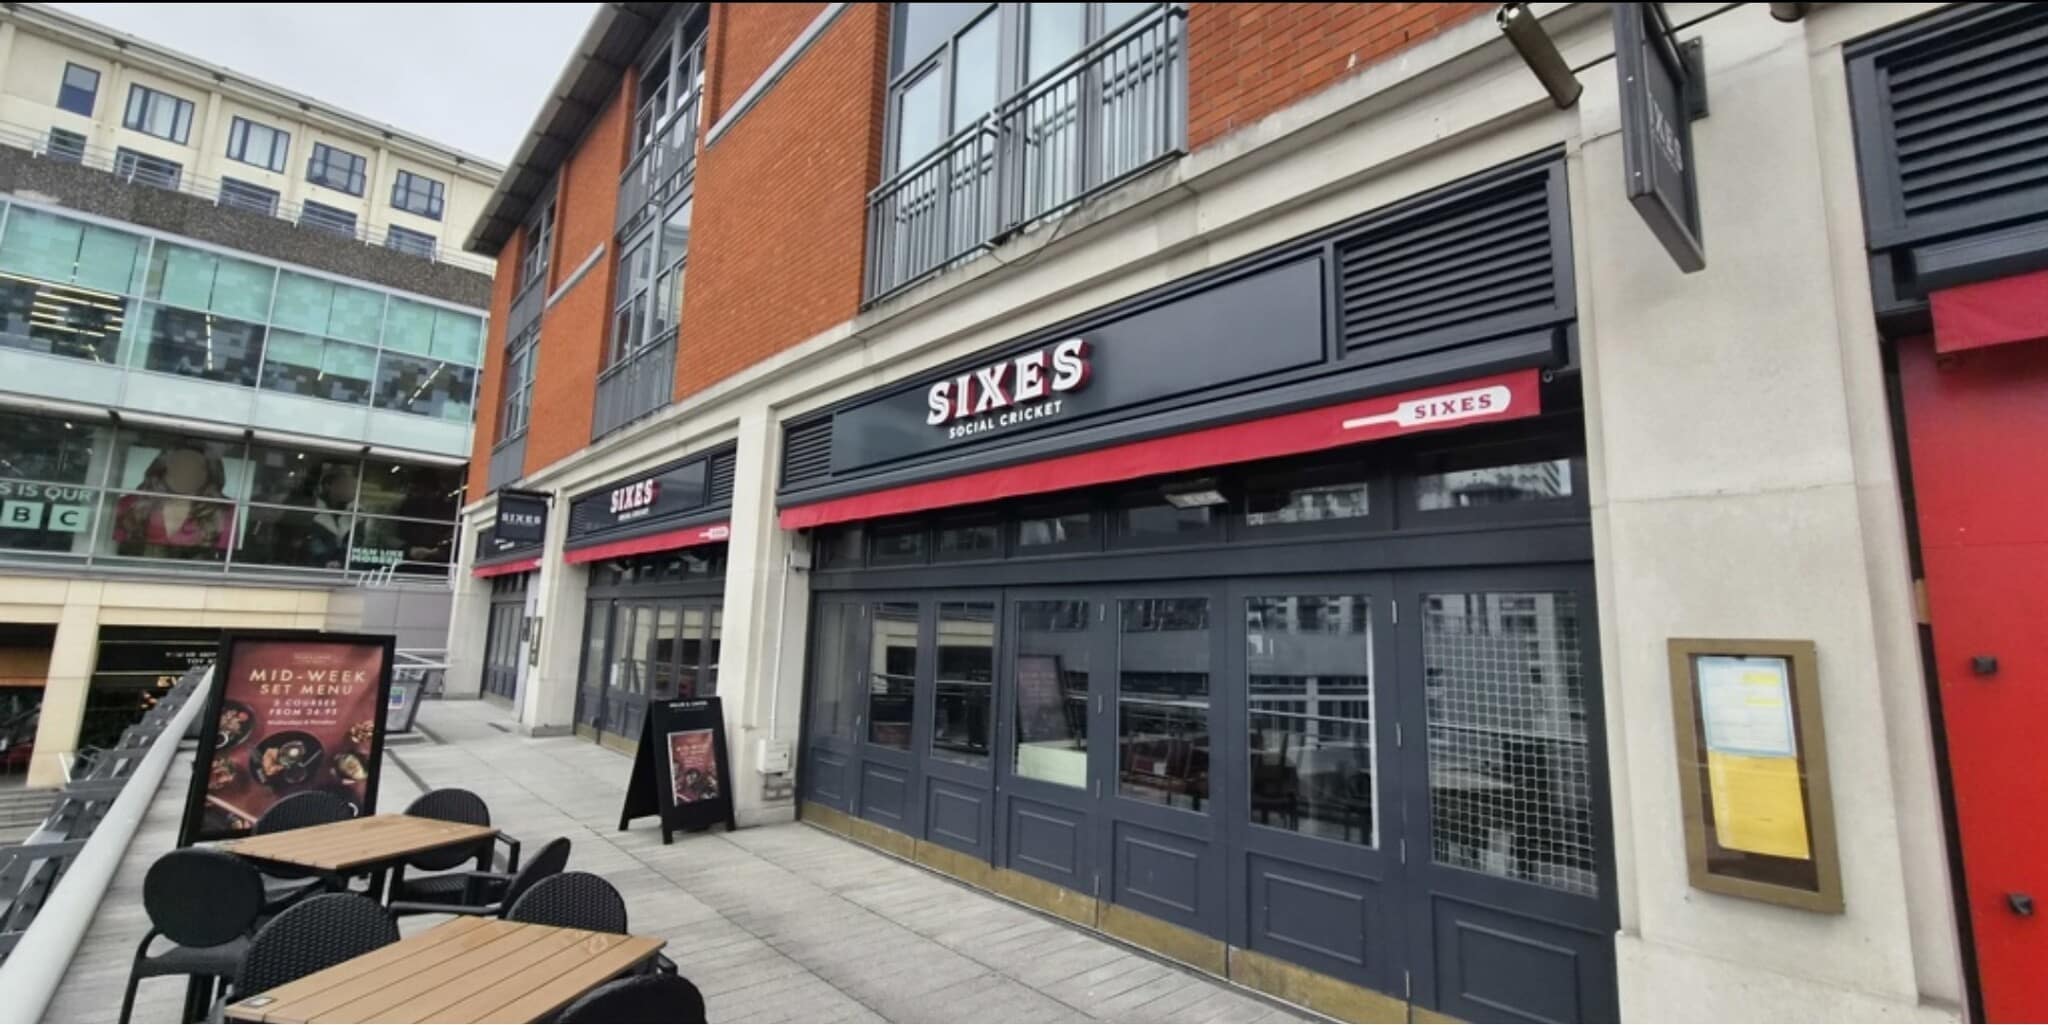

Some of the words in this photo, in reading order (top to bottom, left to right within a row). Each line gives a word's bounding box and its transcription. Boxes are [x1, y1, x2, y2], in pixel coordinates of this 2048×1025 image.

[926, 338, 1086, 425] SIXES
[1413, 393, 1493, 420] SIXES
[948, 419, 995, 440] SOCIAL
[999, 400, 1062, 427] CRICKET
[18, 483, 39, 498] IS
[609, 478, 654, 514] SIXES
[501, 511, 542, 526] SIXES
[249, 668, 367, 683] MID-WEEK
[259, 683, 292, 696] SET
[300, 684, 353, 696] MENU
[285, 699, 337, 708] COURSES
[268, 708, 302, 716] FROM
